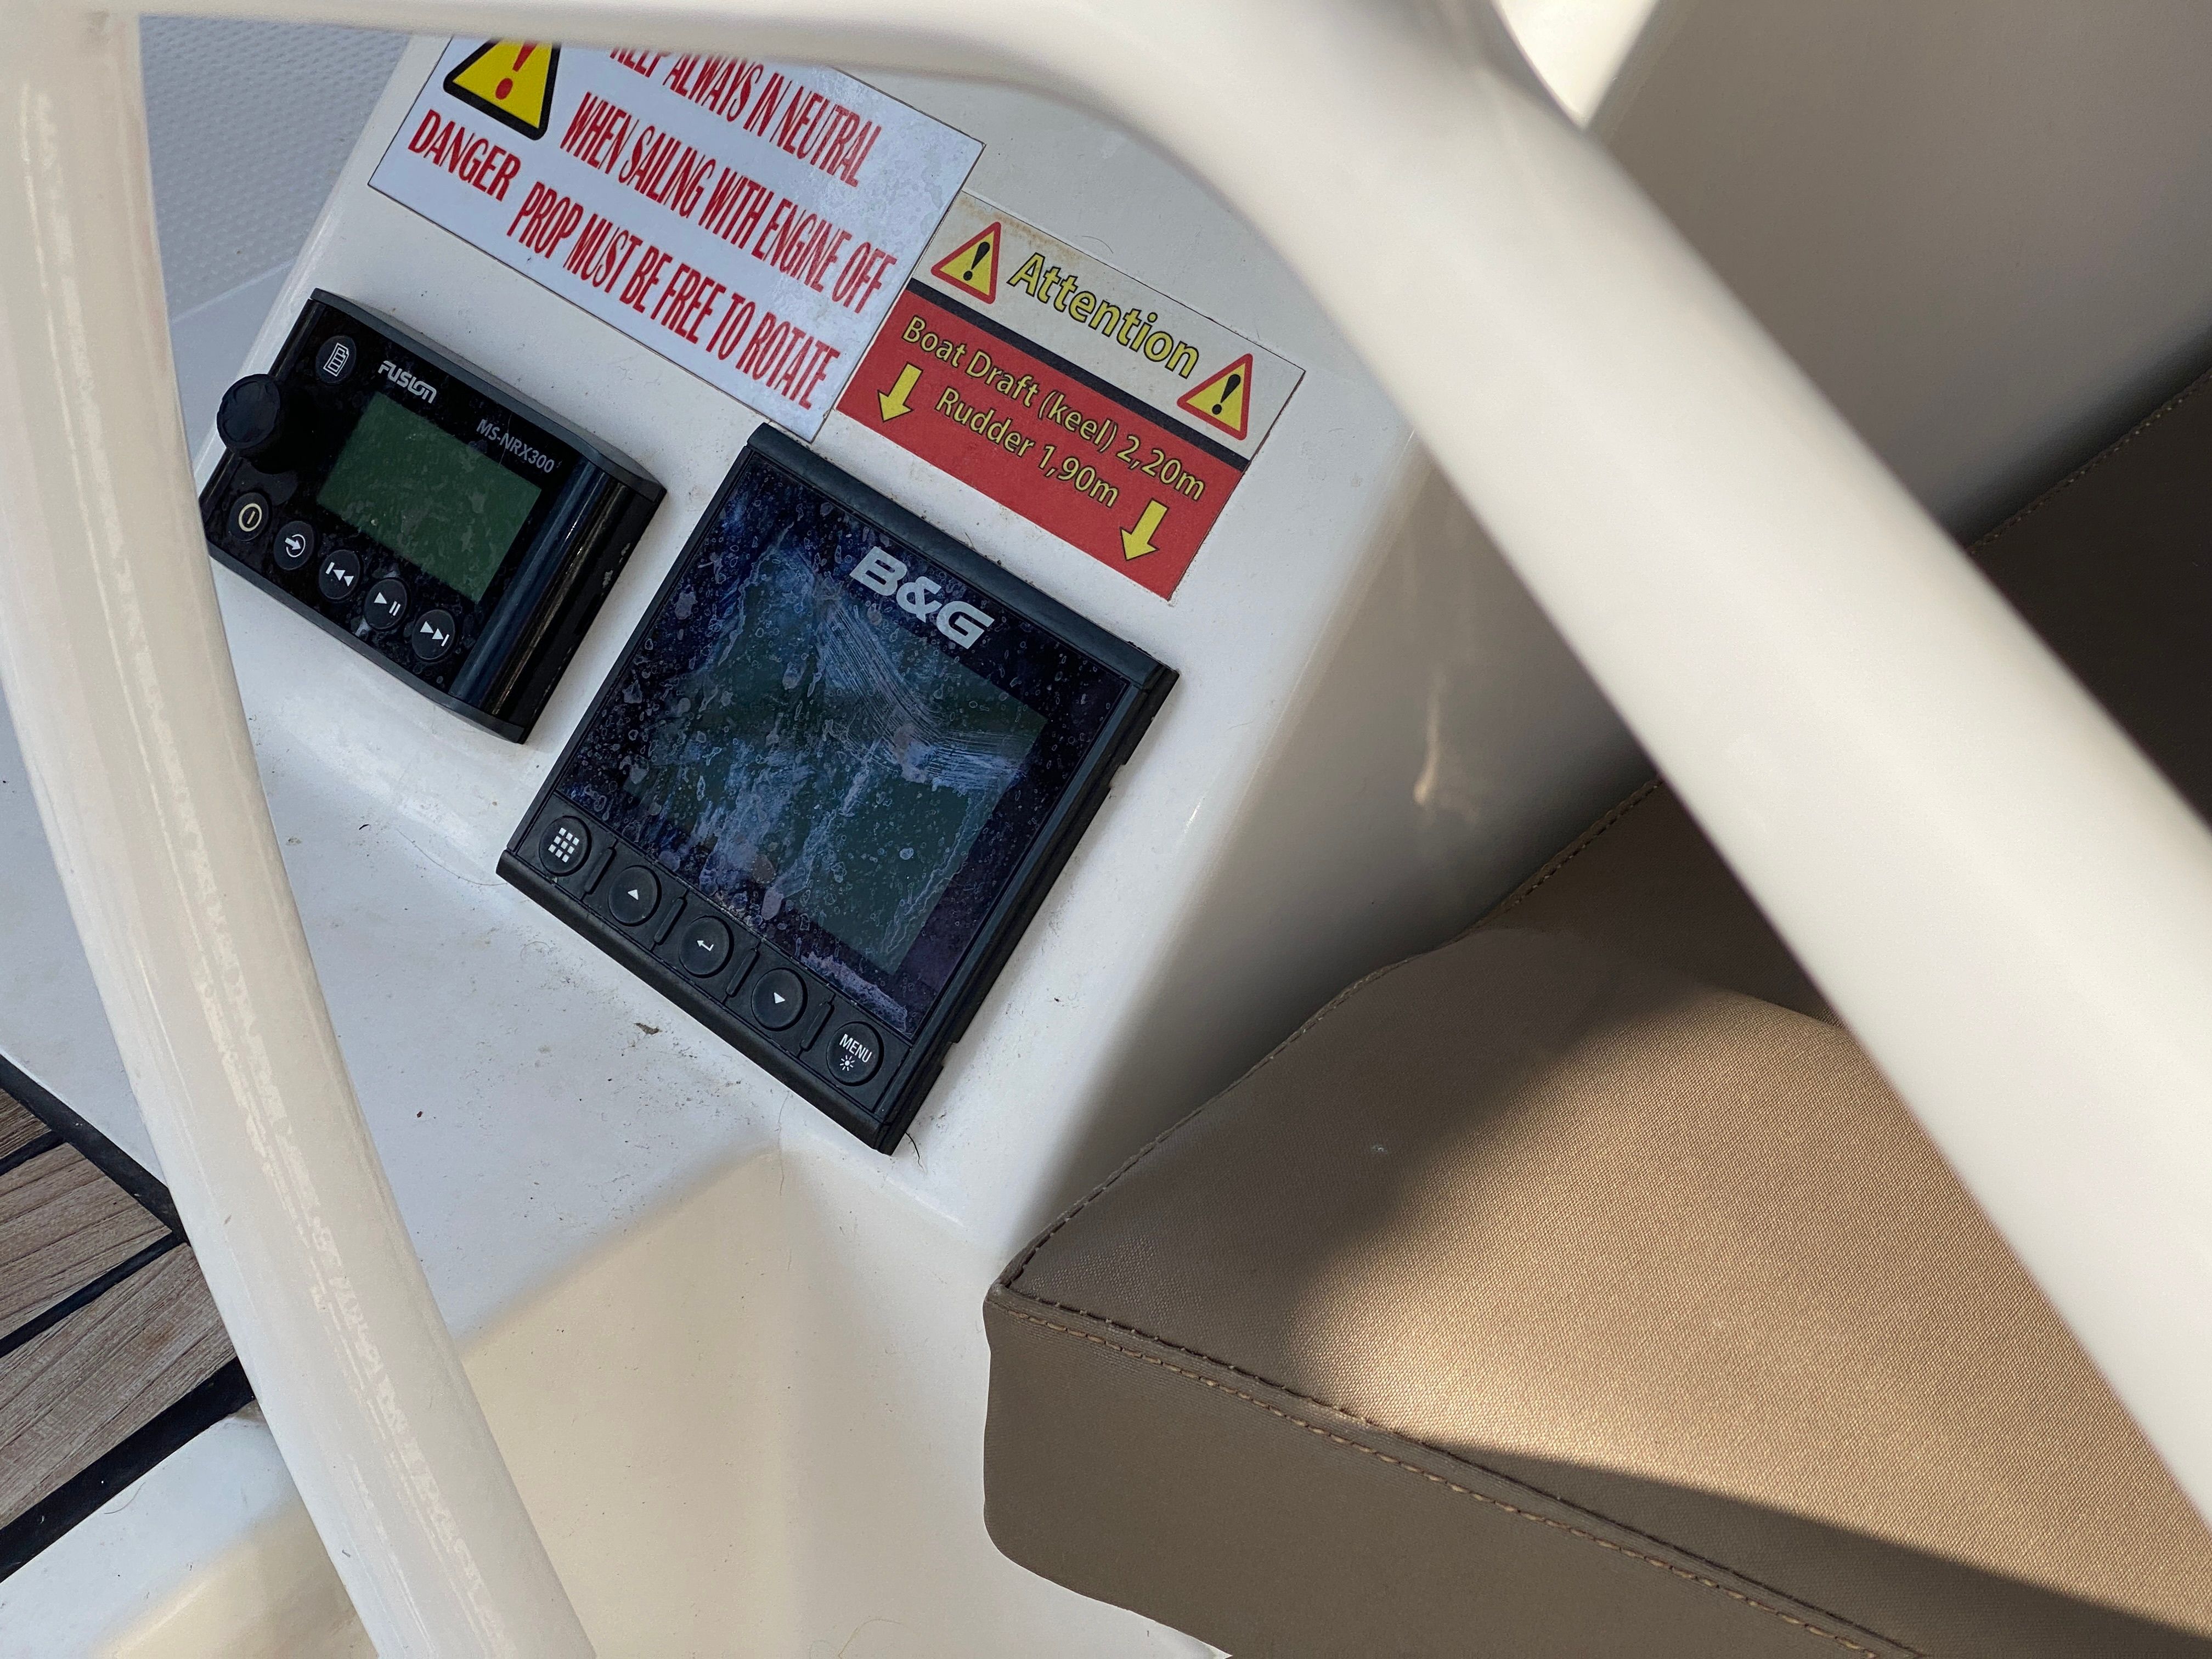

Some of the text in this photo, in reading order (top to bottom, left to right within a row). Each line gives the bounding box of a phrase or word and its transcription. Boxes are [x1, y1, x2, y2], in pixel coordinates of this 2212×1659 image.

[409, 110, 521, 201] DANGER
[662, 53, 764, 122] ALWAYS
[742, 71, 792, 137] IN
[769, 85, 882, 187] NEUTRAL
[560, 92, 897, 313] WHEN SAILING WITH ENGINE OFF
[506, 181, 840, 410] PROP MUST BE FREE TO ROTATE
[1006, 252, 1199, 379] Attention
[377, 360, 437, 404] FUSION
[901, 314, 1206, 501] Boat Draft (keel) 2,20m
[476, 419, 555, 473] MS-NRX300
[935, 386, 1120, 509] Rudder 1,90m
[849, 545, 995, 650] B&G
[839, 1034, 872, 1063] MENU
